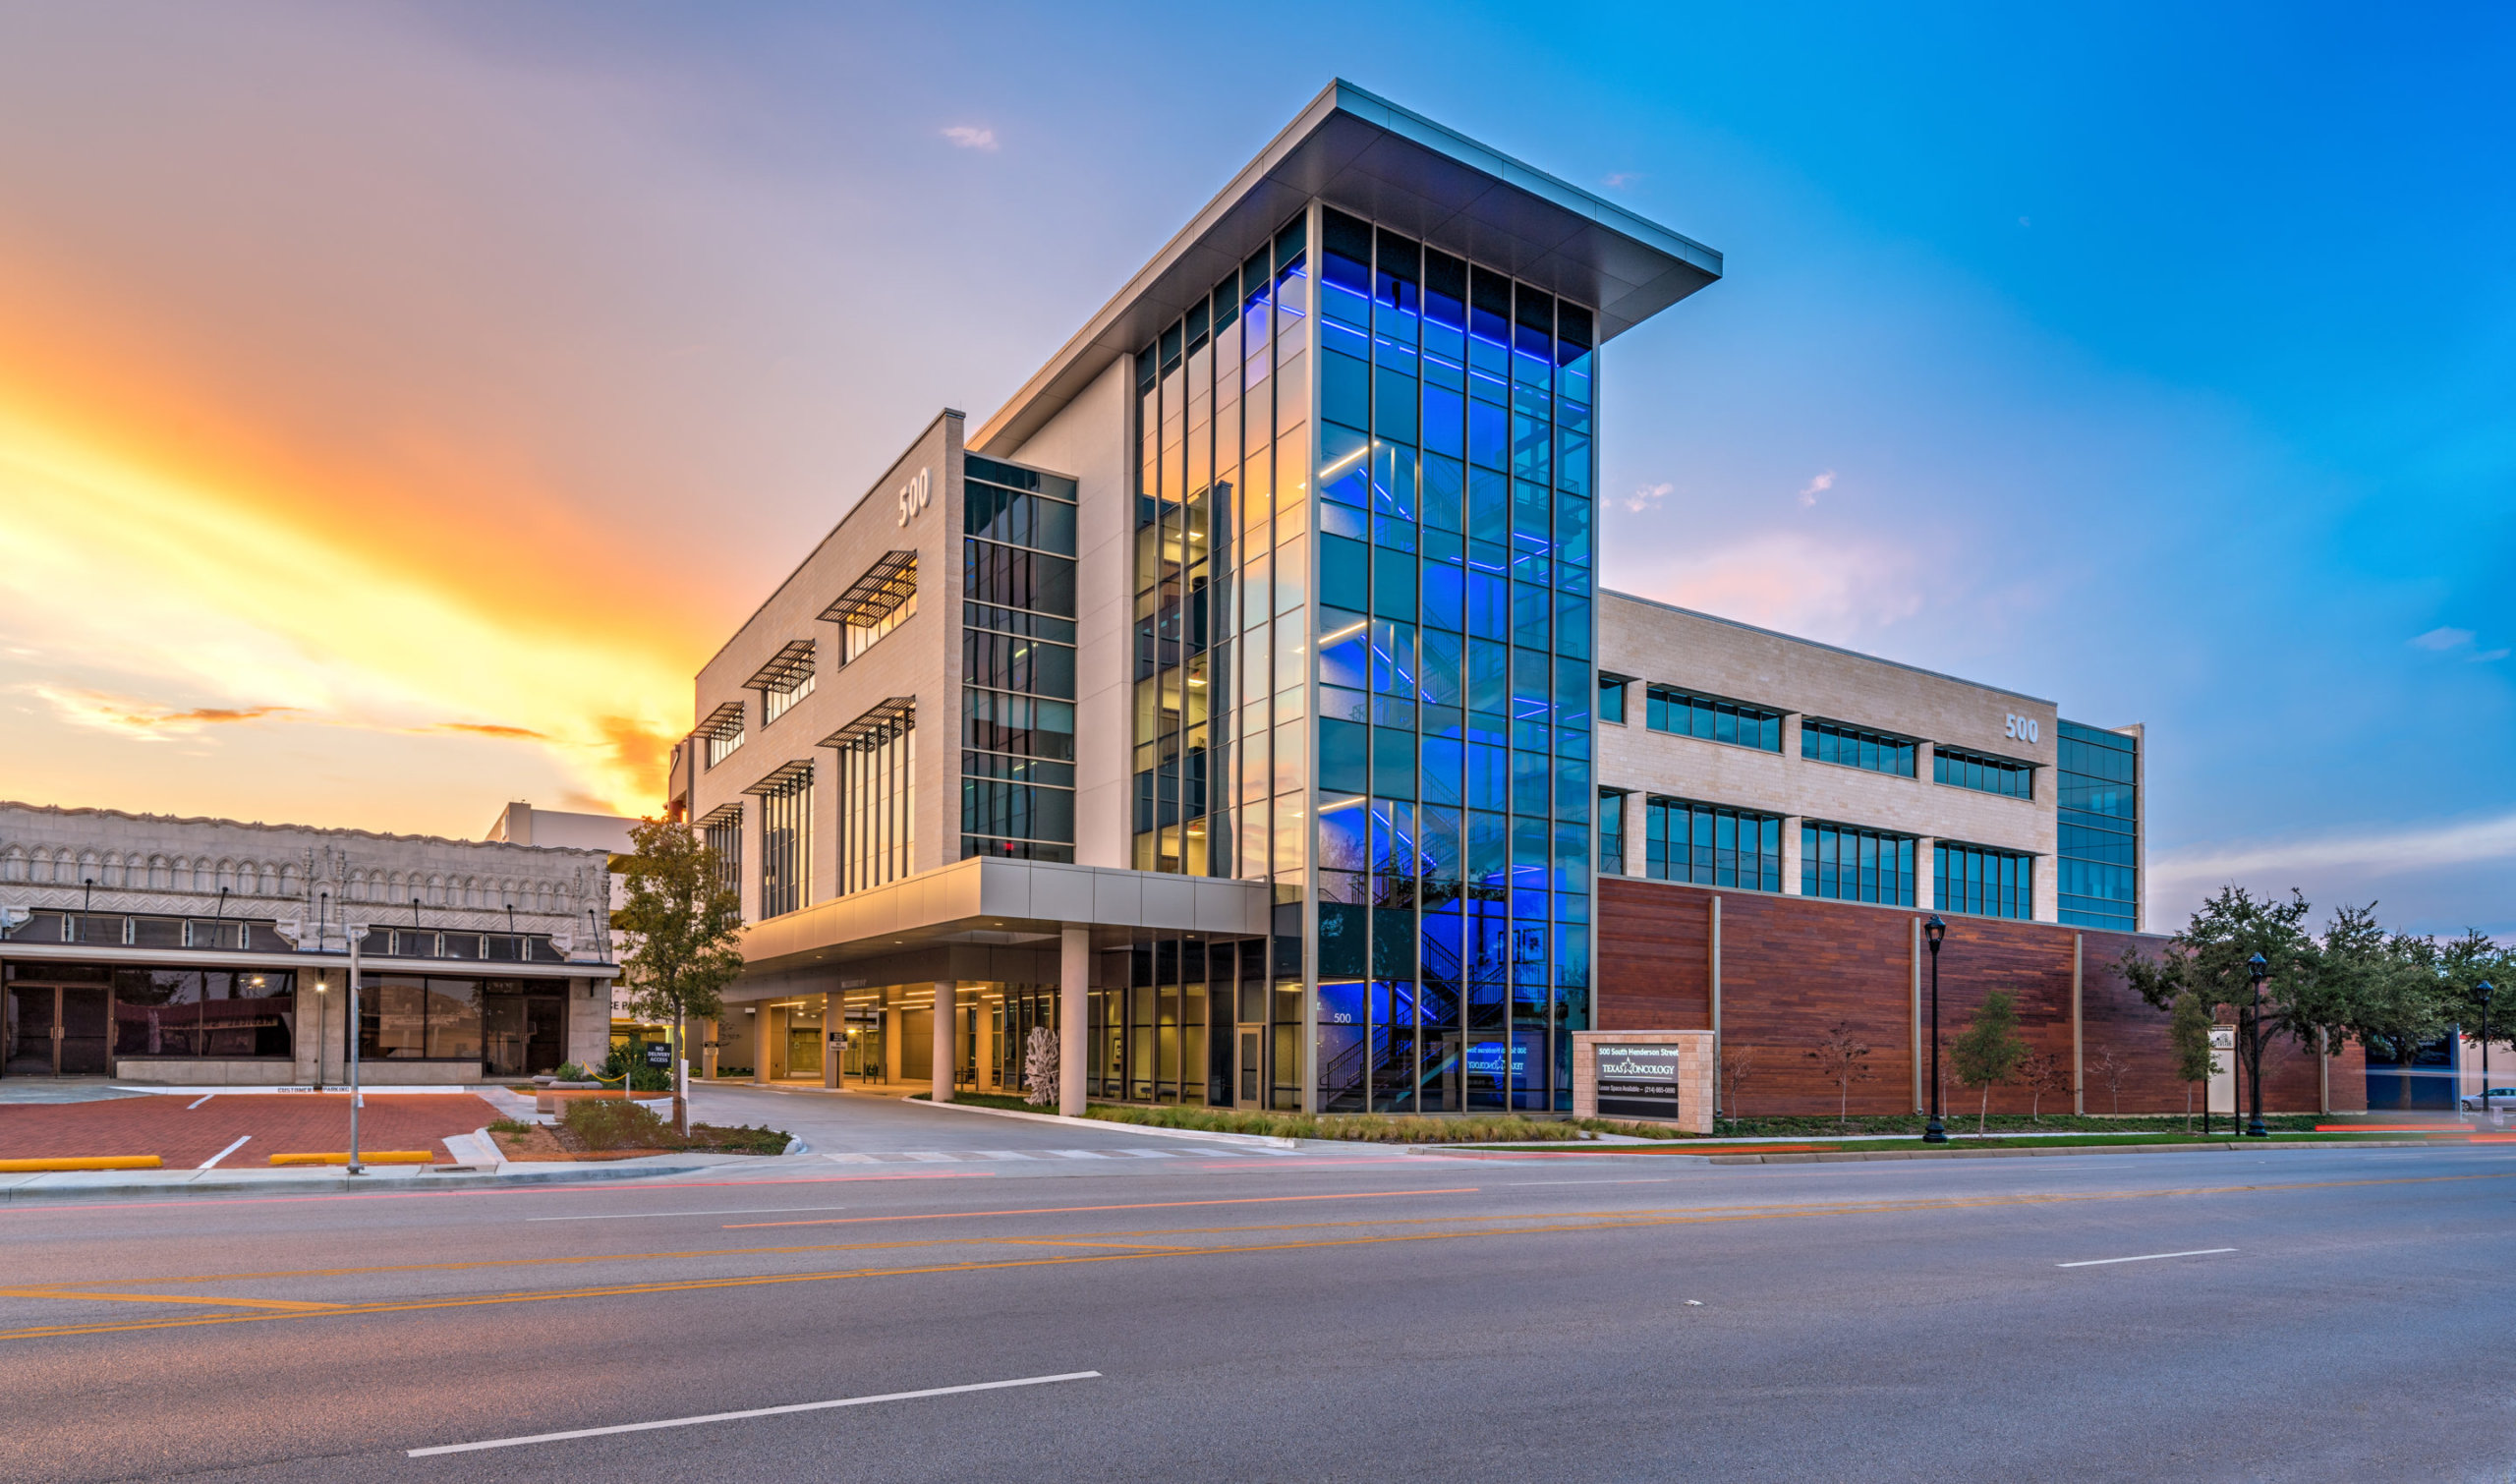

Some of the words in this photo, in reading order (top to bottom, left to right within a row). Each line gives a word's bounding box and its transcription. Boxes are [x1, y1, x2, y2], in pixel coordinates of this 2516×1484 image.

[898, 467, 930, 527] 500
[2005, 713, 2038, 743] 500
[1334, 1012, 1351, 1023] 500
[1629, 1048, 1659, 1056] Henderson
[1661, 1048, 1679, 1056] Street
[1602, 1064, 1624, 1073] TEXAS
[1632, 1064, 1675, 1074] ONCOLOGY
